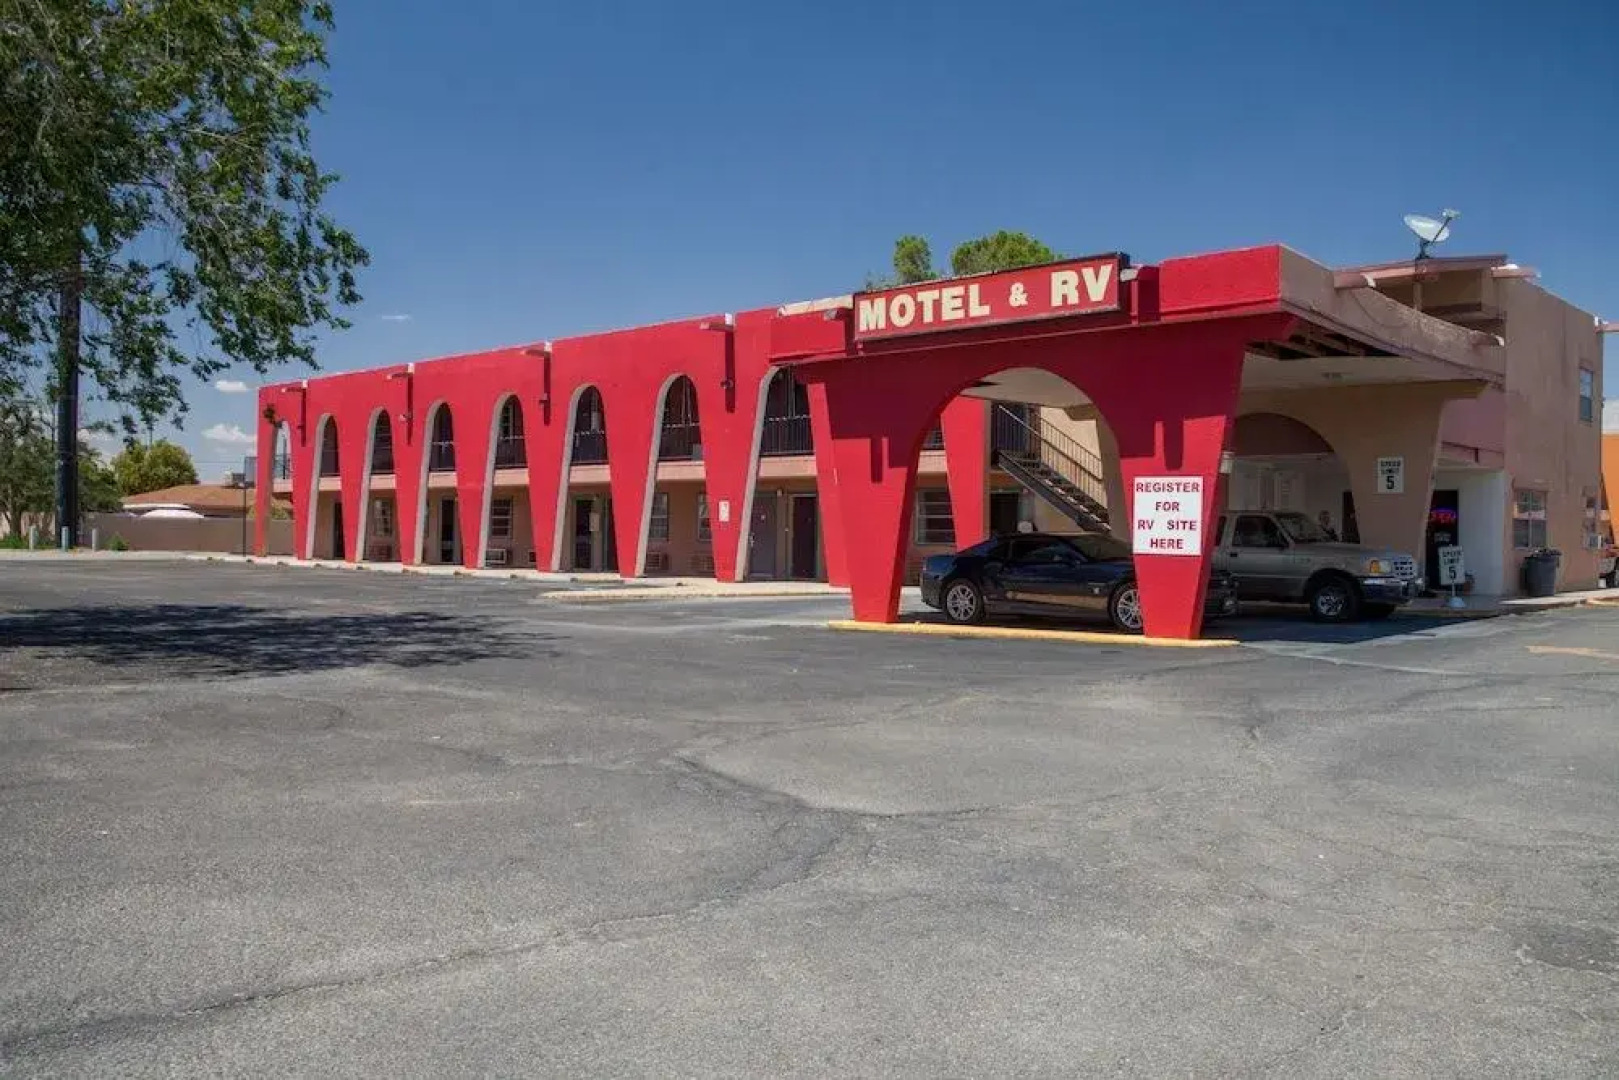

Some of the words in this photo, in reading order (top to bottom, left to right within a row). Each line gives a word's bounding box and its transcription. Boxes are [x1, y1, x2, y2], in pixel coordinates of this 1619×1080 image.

[858, 284, 990, 332] MOTEL
[1008, 282, 1028, 307] &
[1050, 264, 1113, 307] RV
[1136, 482, 1200, 493] REGISTER
[1386, 475, 1395, 490] 5
[1155, 501, 1180, 512] FOR
[1137, 519, 1154, 531] RV
[1166, 519, 1197, 531] SITE
[1150, 538, 1184, 550] HERE
[1448, 566, 1457, 579] 5
